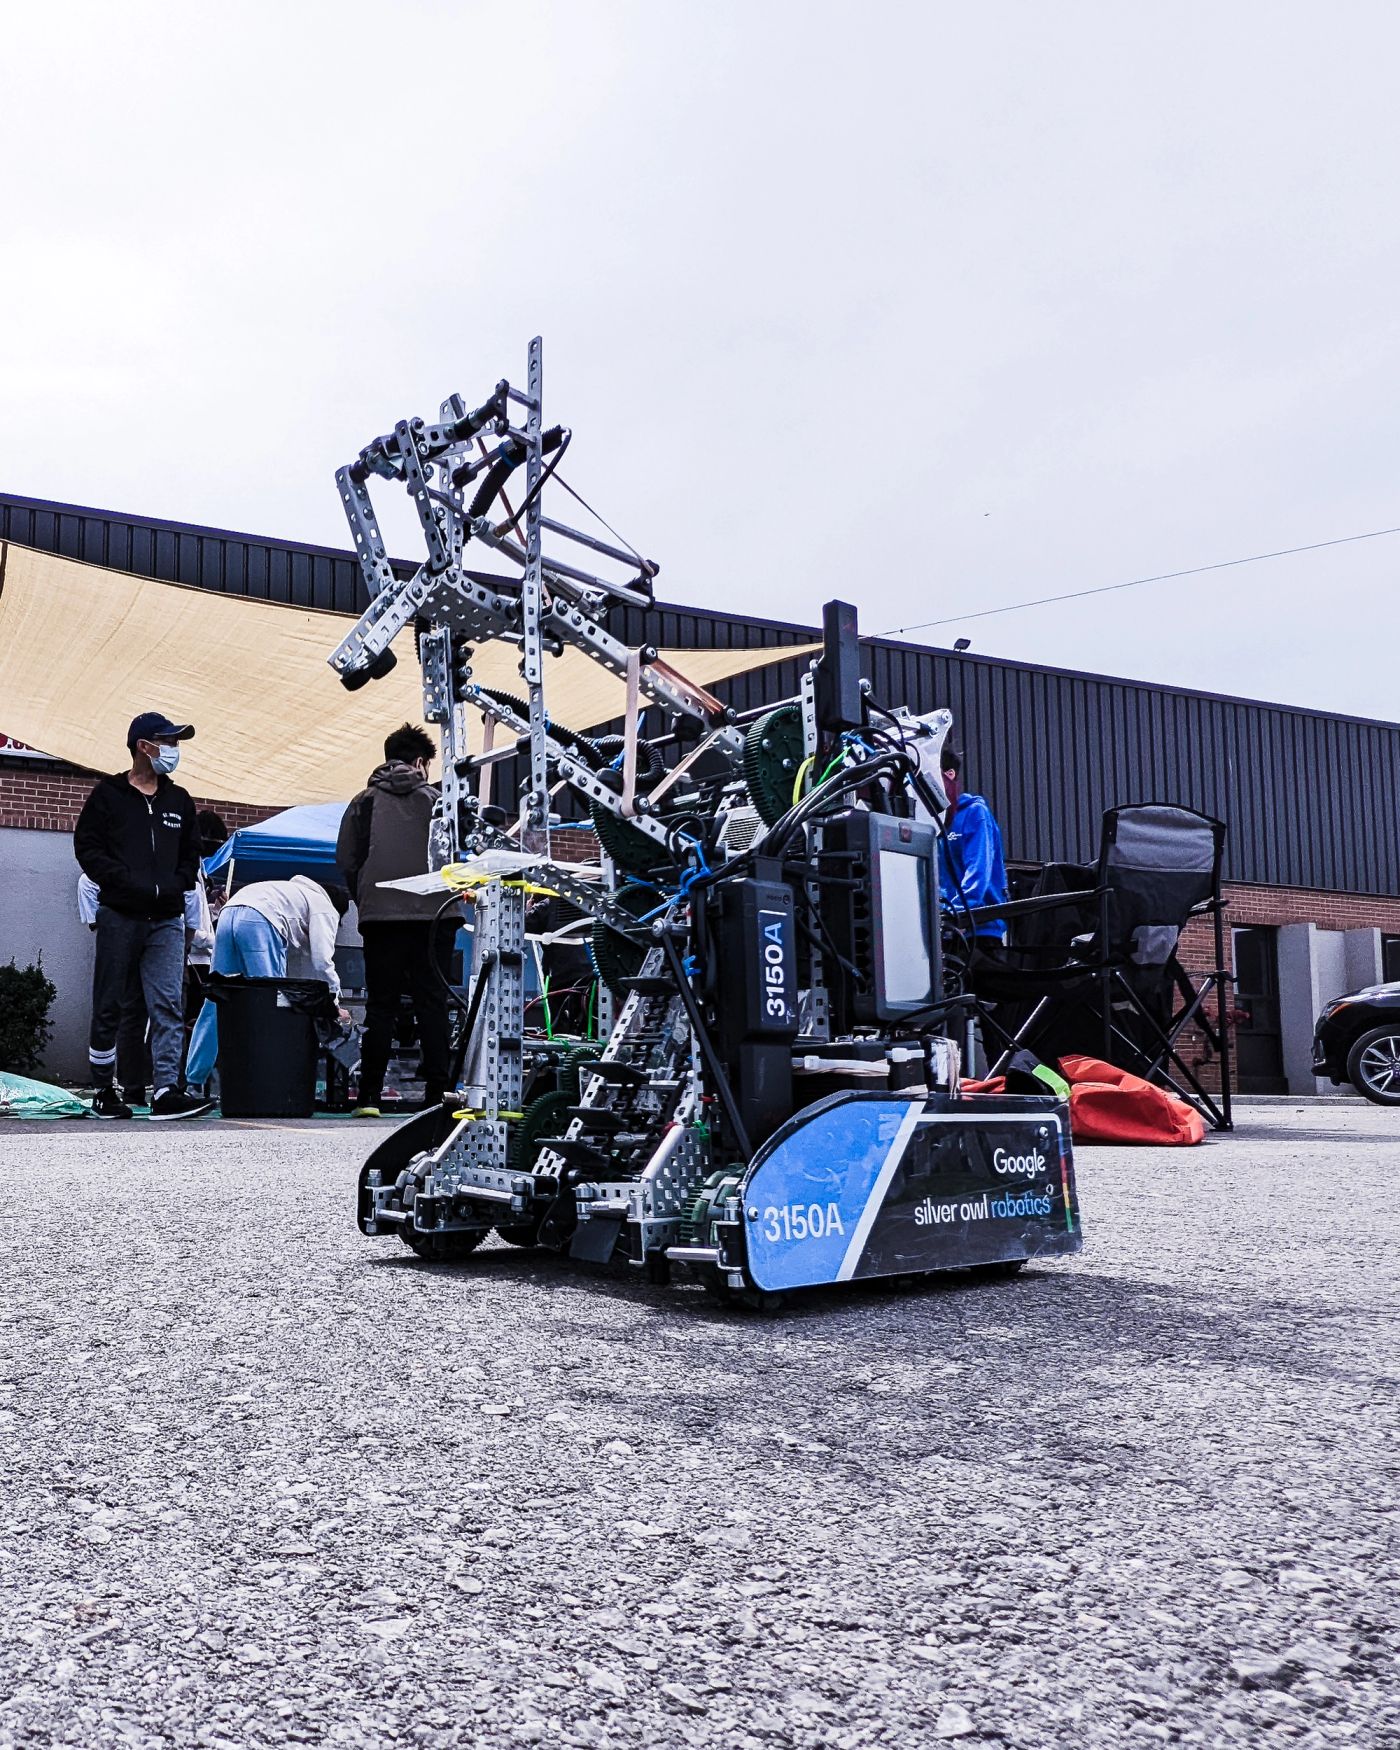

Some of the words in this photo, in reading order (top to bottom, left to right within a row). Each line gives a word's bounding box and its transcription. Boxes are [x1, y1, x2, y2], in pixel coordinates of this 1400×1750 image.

[764, 922, 785, 1017] 3150A
[993, 1147, 1046, 1179] Google
[763, 1202, 845, 1242] 3150A
[914, 1197, 958, 1225] silver
[960, 1193, 989, 1221] owl
[990, 1191, 1051, 1219] robotics
